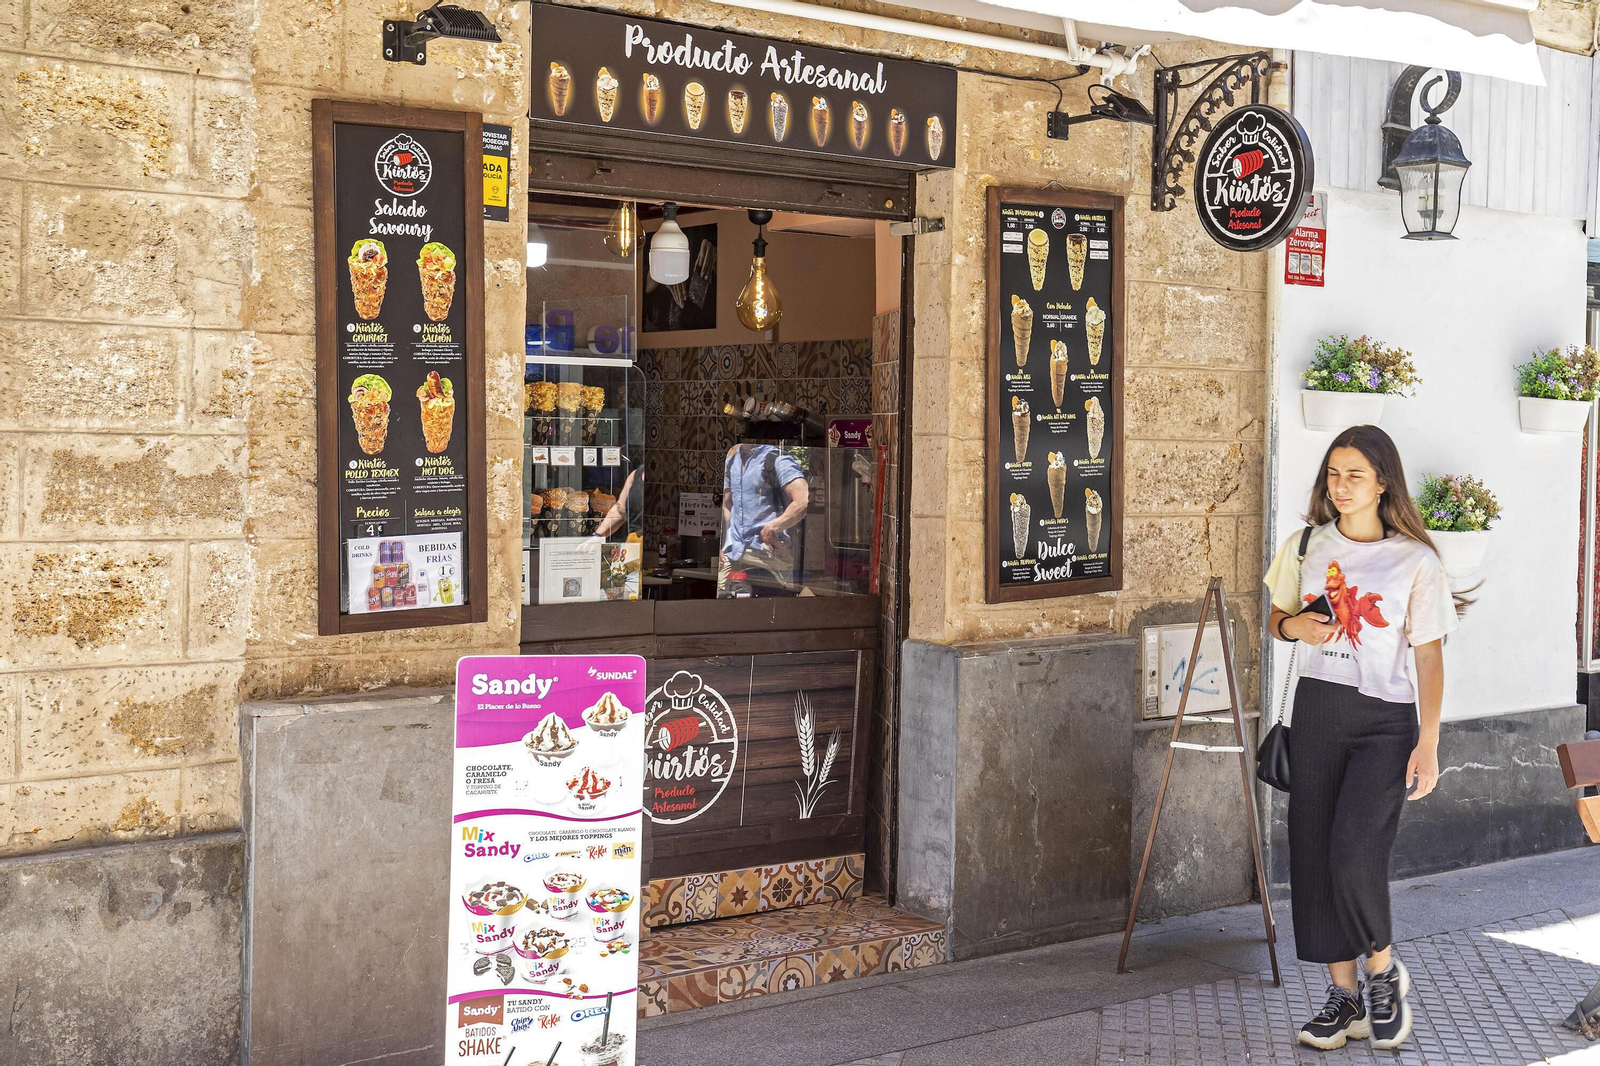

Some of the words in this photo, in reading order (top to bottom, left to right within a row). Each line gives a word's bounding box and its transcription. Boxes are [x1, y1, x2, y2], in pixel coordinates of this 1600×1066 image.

[625, 23, 753, 75] Producto
[760, 45, 887, 94] Artesanal
[482, 132, 508, 140] OVISTAR
[482, 138, 509, 146] ROSEGUR
[1212, 136, 1236, 168] Sabor
[1262, 130, 1290, 166] Calidad
[382, 164, 427, 180] Kürtös
[1214, 174, 1286, 206] Kürtös
[374, 198, 428, 218] Salado
[1229, 206, 1262, 218] Producto
[369, 216, 434, 242] Savoury
[1228, 218, 1262, 230] Artesanal
[1295, 228, 1318, 239] Alarma
[355, 322, 384, 333] Kürtös
[352, 334, 389, 343] GOURMET
[844, 431, 861, 440] Sandy
[357, 458, 387, 470] Kürtös
[424, 456, 452, 467] Kürtös
[345, 469, 368, 479] POLLO
[371, 468, 400, 478] TEXMEX
[422, 467, 436, 476] HOT
[438, 466, 455, 475] DOG
[356, 506, 390, 518] Precios
[414, 508, 436, 517] Salsas
[443, 506, 462, 518] elegir
[366, 524, 374, 536] 4
[418, 542, 457, 552] BEBIDAS
[1038, 538, 1076, 560] Dulce
[426, 553, 453, 563] FRÍAS
[1034, 558, 1073, 582] Sweet
[596, 671, 633, 680] SUNDAE
[698, 694, 731, 734] Calidad
[654, 785, 695, 798] Producto
[652, 798, 697, 813] Artesanal
[462, 827, 495, 843] Mix
[464, 841, 521, 858] Sandy
[550, 897, 565, 905] Mix
[552, 900, 578, 911] Sandy
[593, 917, 610, 926] Mix
[596, 920, 624, 933] Sandy
[472, 922, 495, 934] Mix
[476, 925, 515, 943] Sandy
[526, 962, 543, 970] Mix
[529, 962, 559, 977] Sandy
[463, 1005, 499, 1016] Sandy
[570, 1006, 610, 1022] OREO
[465, 1027, 496, 1037] BATIDOS
[458, 1037, 502, 1057] SHAKE
